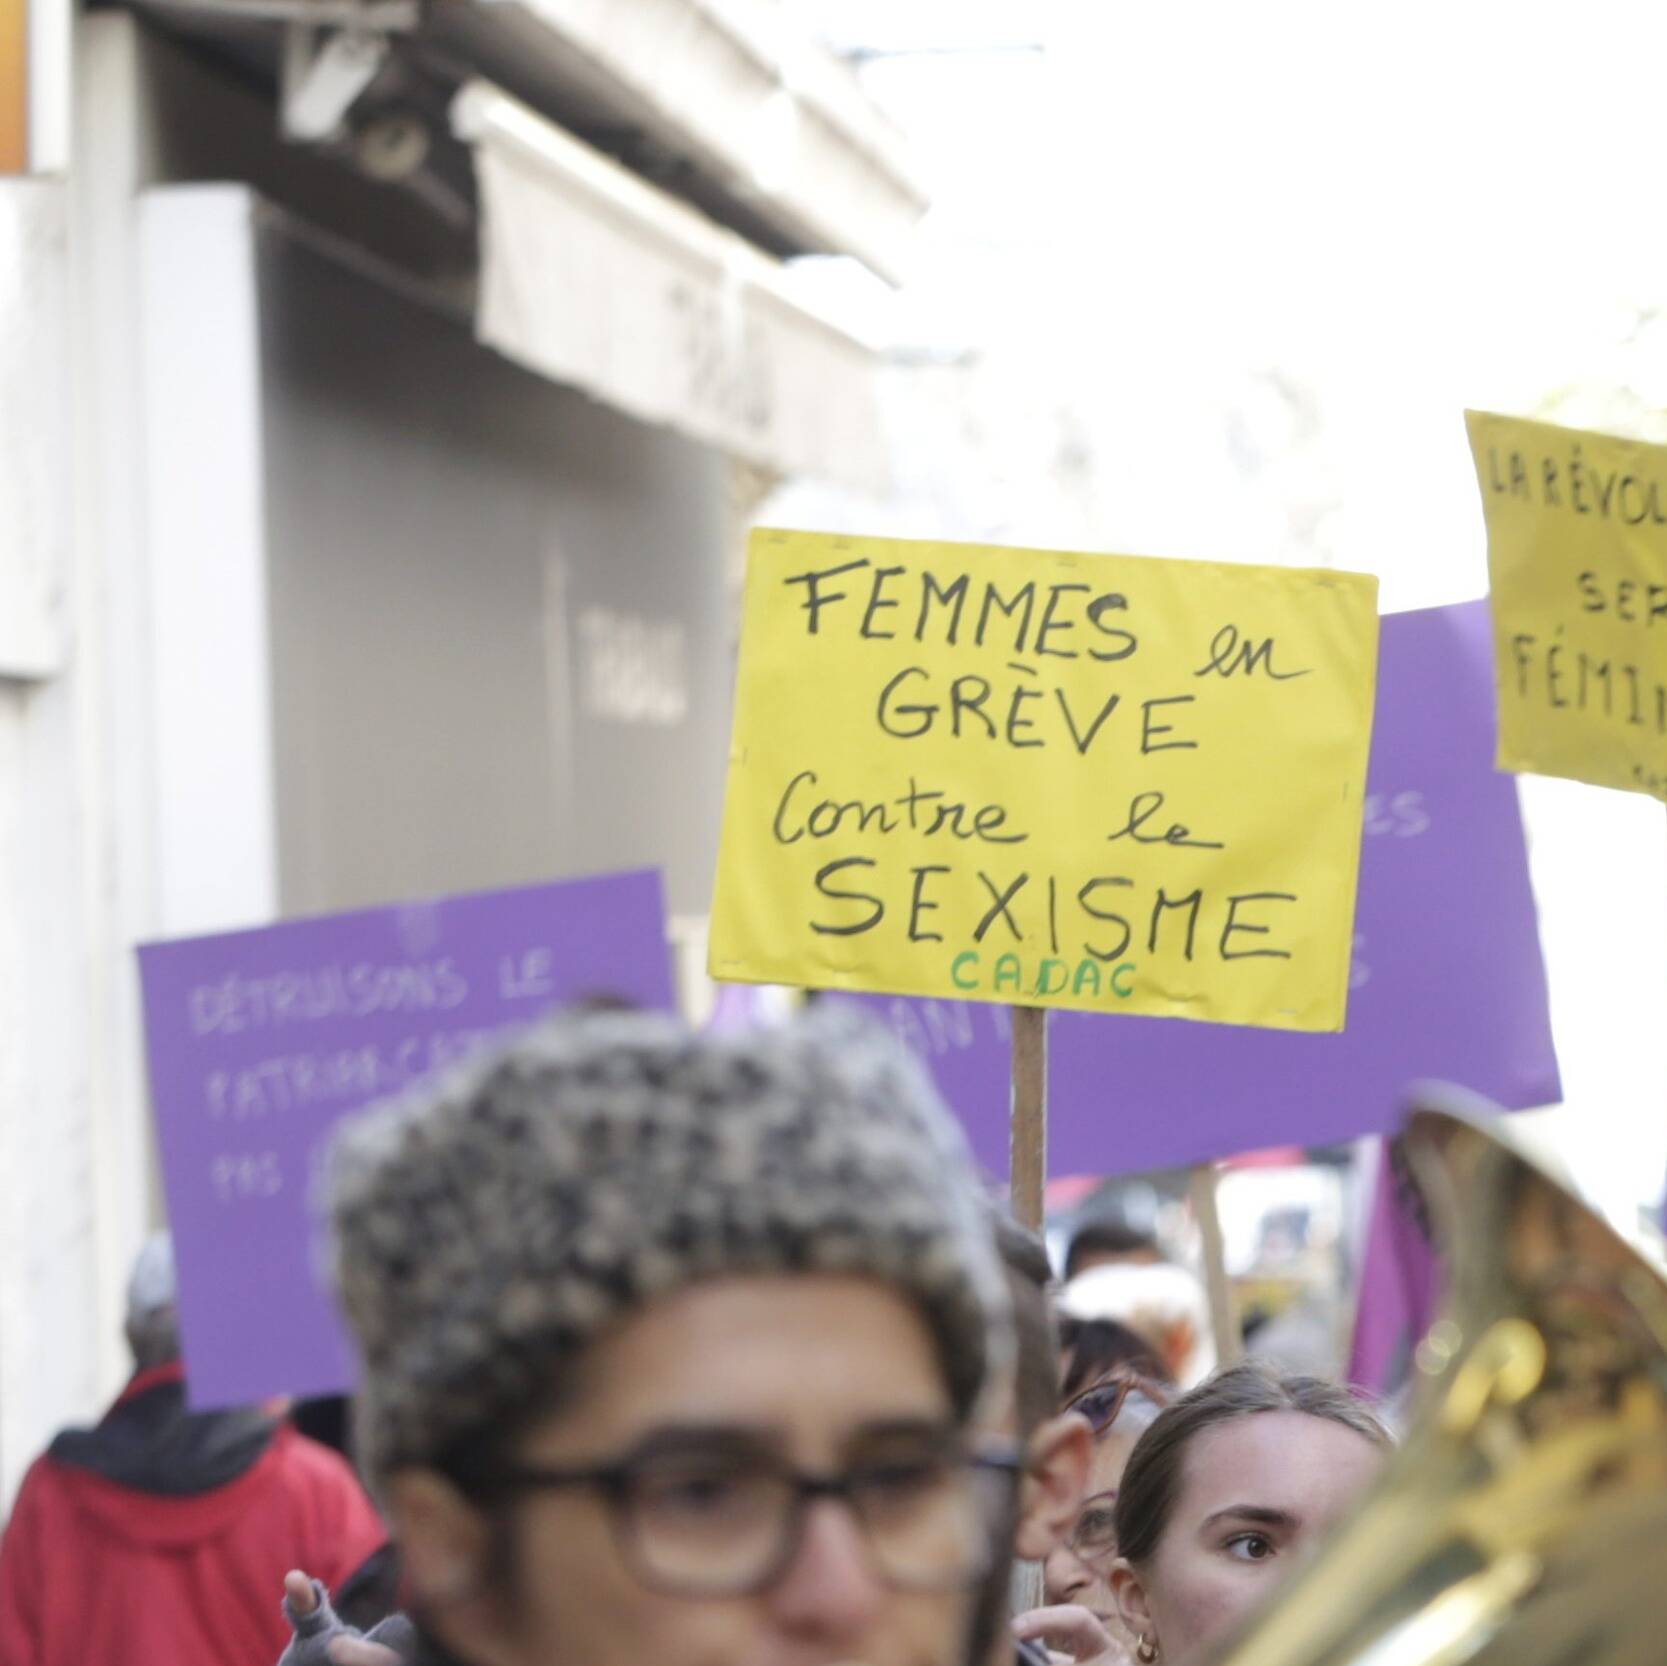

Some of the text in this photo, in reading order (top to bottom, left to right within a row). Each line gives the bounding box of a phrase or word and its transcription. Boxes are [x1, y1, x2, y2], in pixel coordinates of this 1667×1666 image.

[1488, 447, 1531, 499] LA
[784, 559, 1317, 678] FEMMES en
[877, 662, 1200, 755] GRÈVE
[773, 771, 1226, 850] Contre le
[809, 856, 1299, 963] SEXISME
[951, 951, 1138, 999] CADAC
